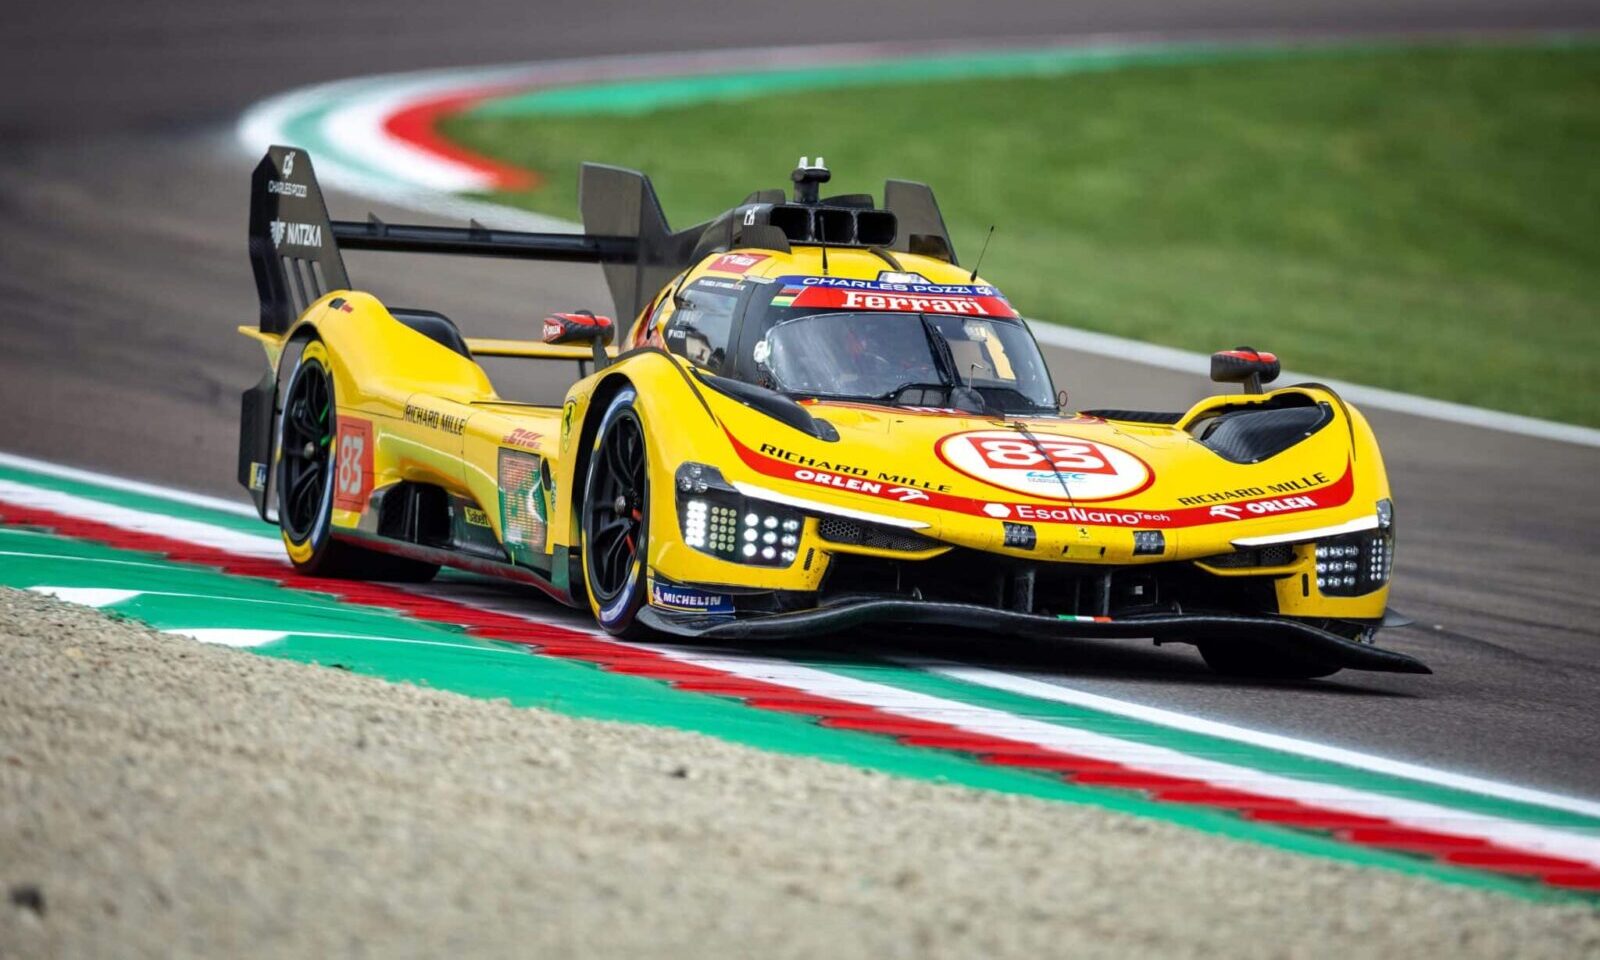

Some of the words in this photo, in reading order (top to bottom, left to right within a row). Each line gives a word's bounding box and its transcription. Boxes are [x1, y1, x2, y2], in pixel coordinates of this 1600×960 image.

[287, 222, 322, 248] NATZKA
[802, 277, 908, 291] CHARLES
[913, 285, 971, 294] POZZI
[842, 290, 989, 315] Ferrari
[405, 405, 439, 429] RICHARD
[440, 414, 465, 436] MILLE
[338, 434, 364, 495] 83
[979, 440, 1105, 470] 83
[760, 443, 868, 476] RICHARD
[878, 472, 953, 493] MILLE
[1026, 471, 1088, 480] WEC
[794, 470, 882, 494] ORLEN
[1177, 486, 1266, 506] RICHARD
[1267, 472, 1330, 494] MILLE
[1245, 496, 1318, 514] ORLEN
[663, 592, 722, 606] MICHELIN
